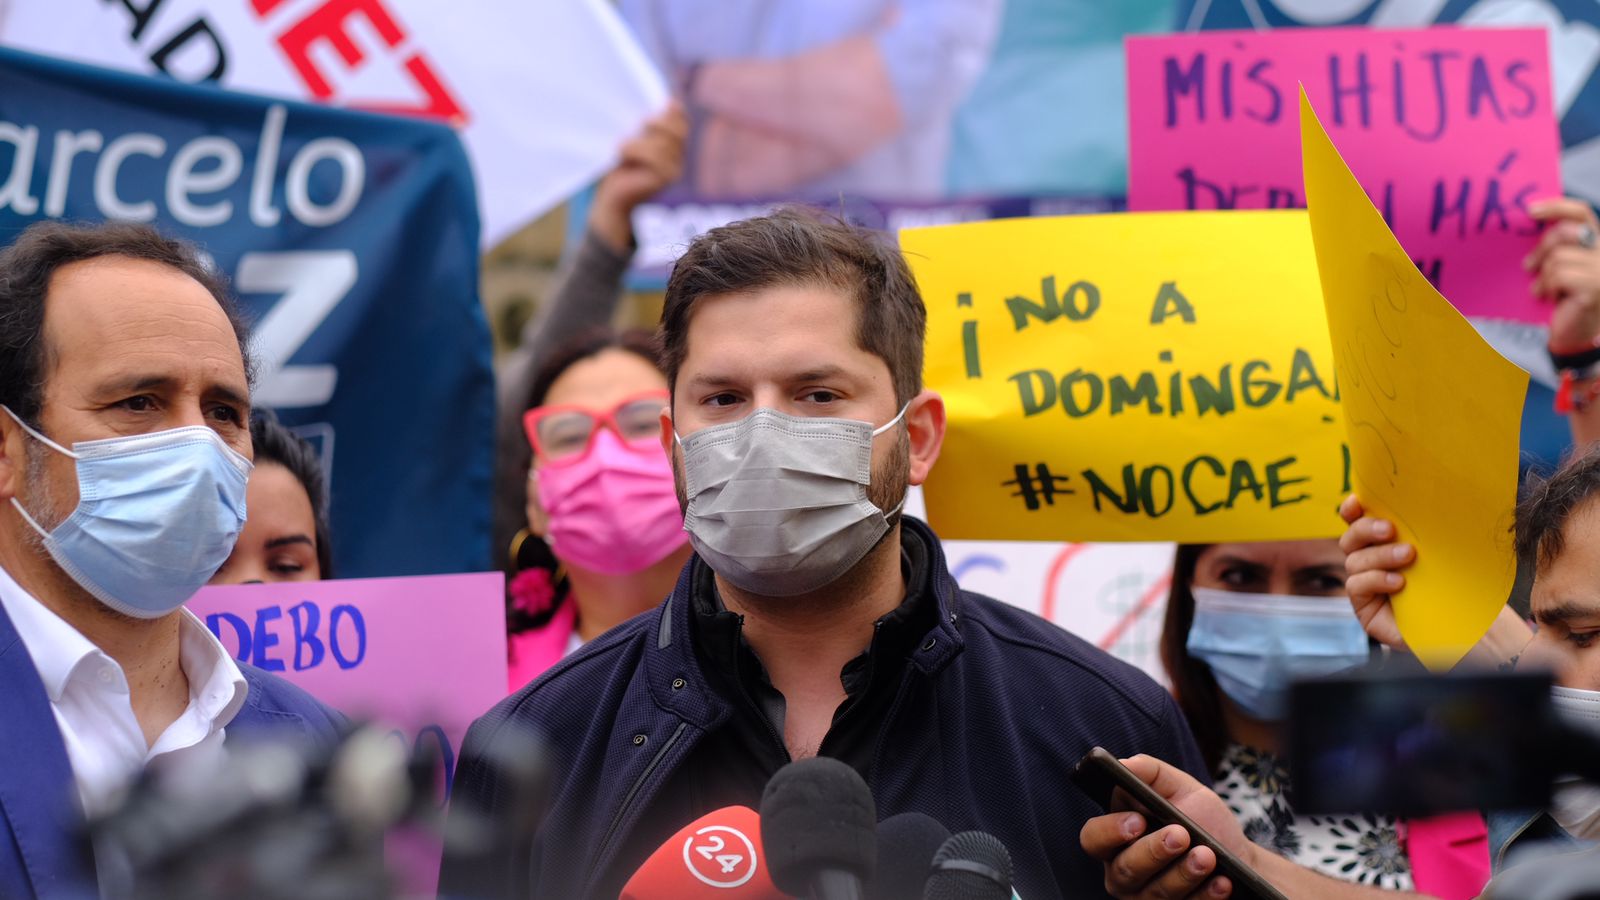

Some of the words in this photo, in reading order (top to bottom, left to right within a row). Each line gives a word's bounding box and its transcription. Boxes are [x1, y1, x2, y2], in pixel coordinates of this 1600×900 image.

[1150, 281, 1197, 324] A
[206, 600, 367, 672] DEBO
[695, 835, 743, 873] 24
